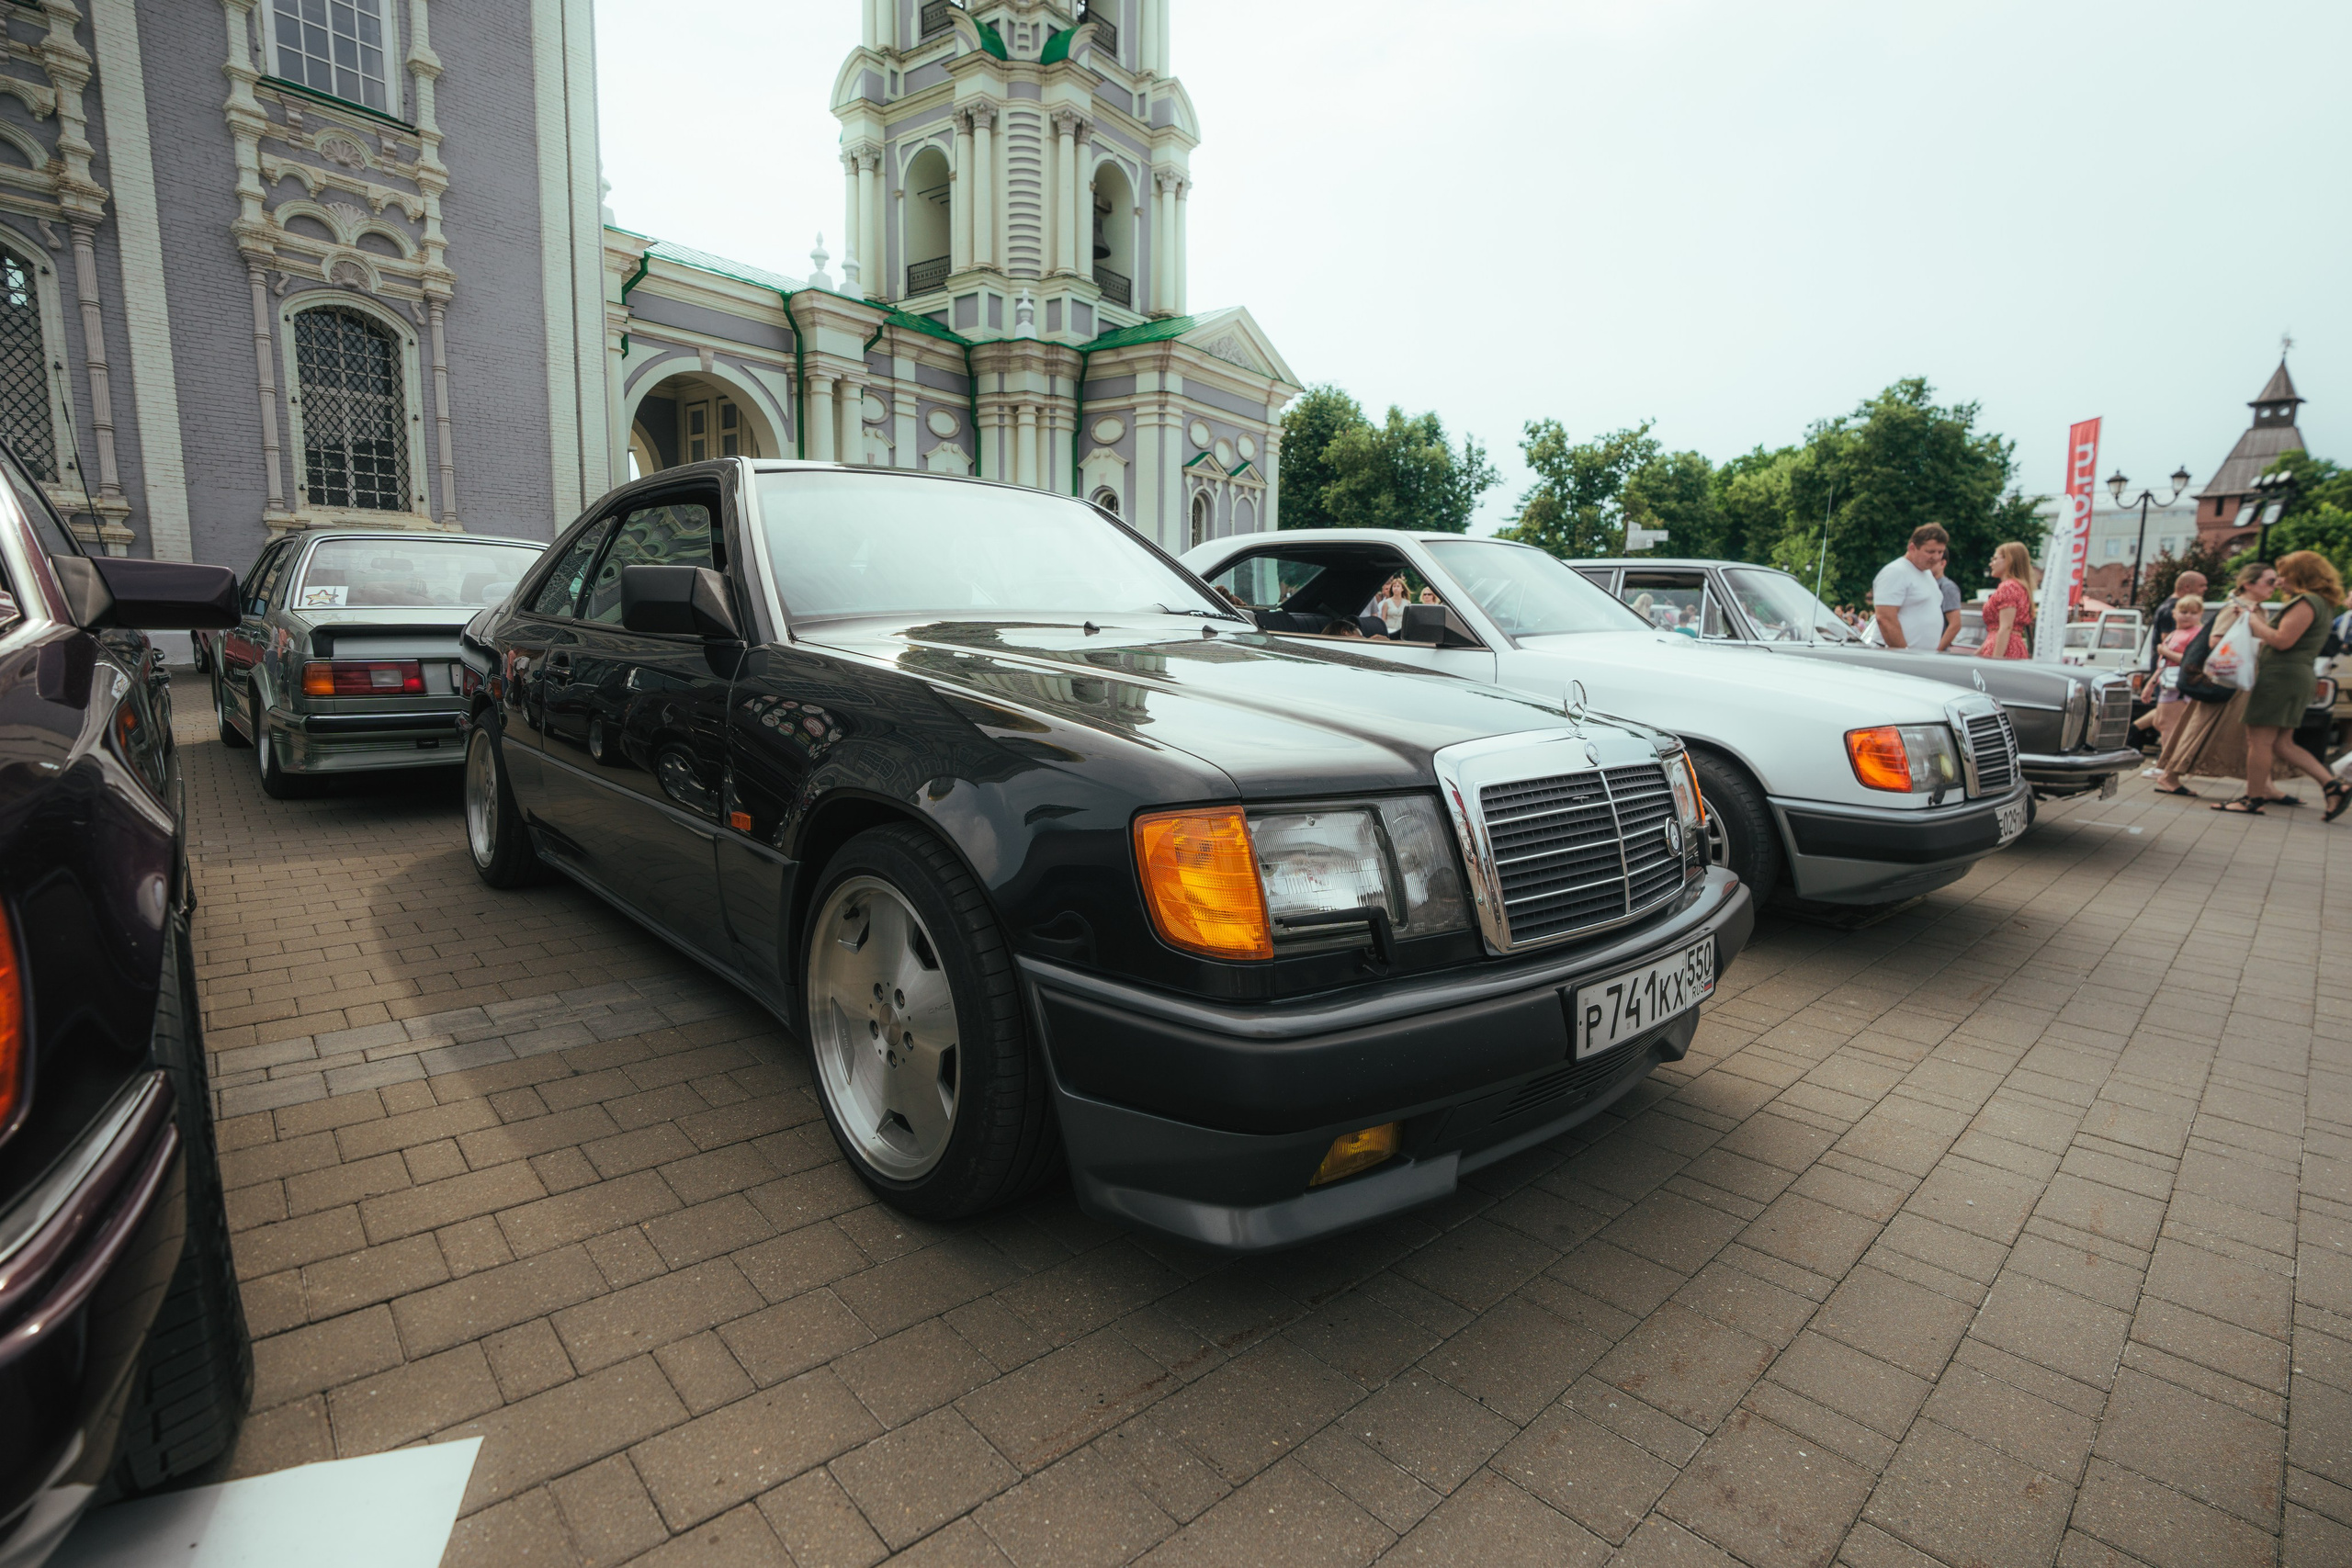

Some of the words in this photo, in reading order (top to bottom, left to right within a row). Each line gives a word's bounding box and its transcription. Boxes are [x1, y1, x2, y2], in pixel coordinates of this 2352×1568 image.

[1586, 968, 1685, 1049] Р741КХ
[1687, 941, 1712, 987] 550
[1691, 980, 1704, 998] RUS
